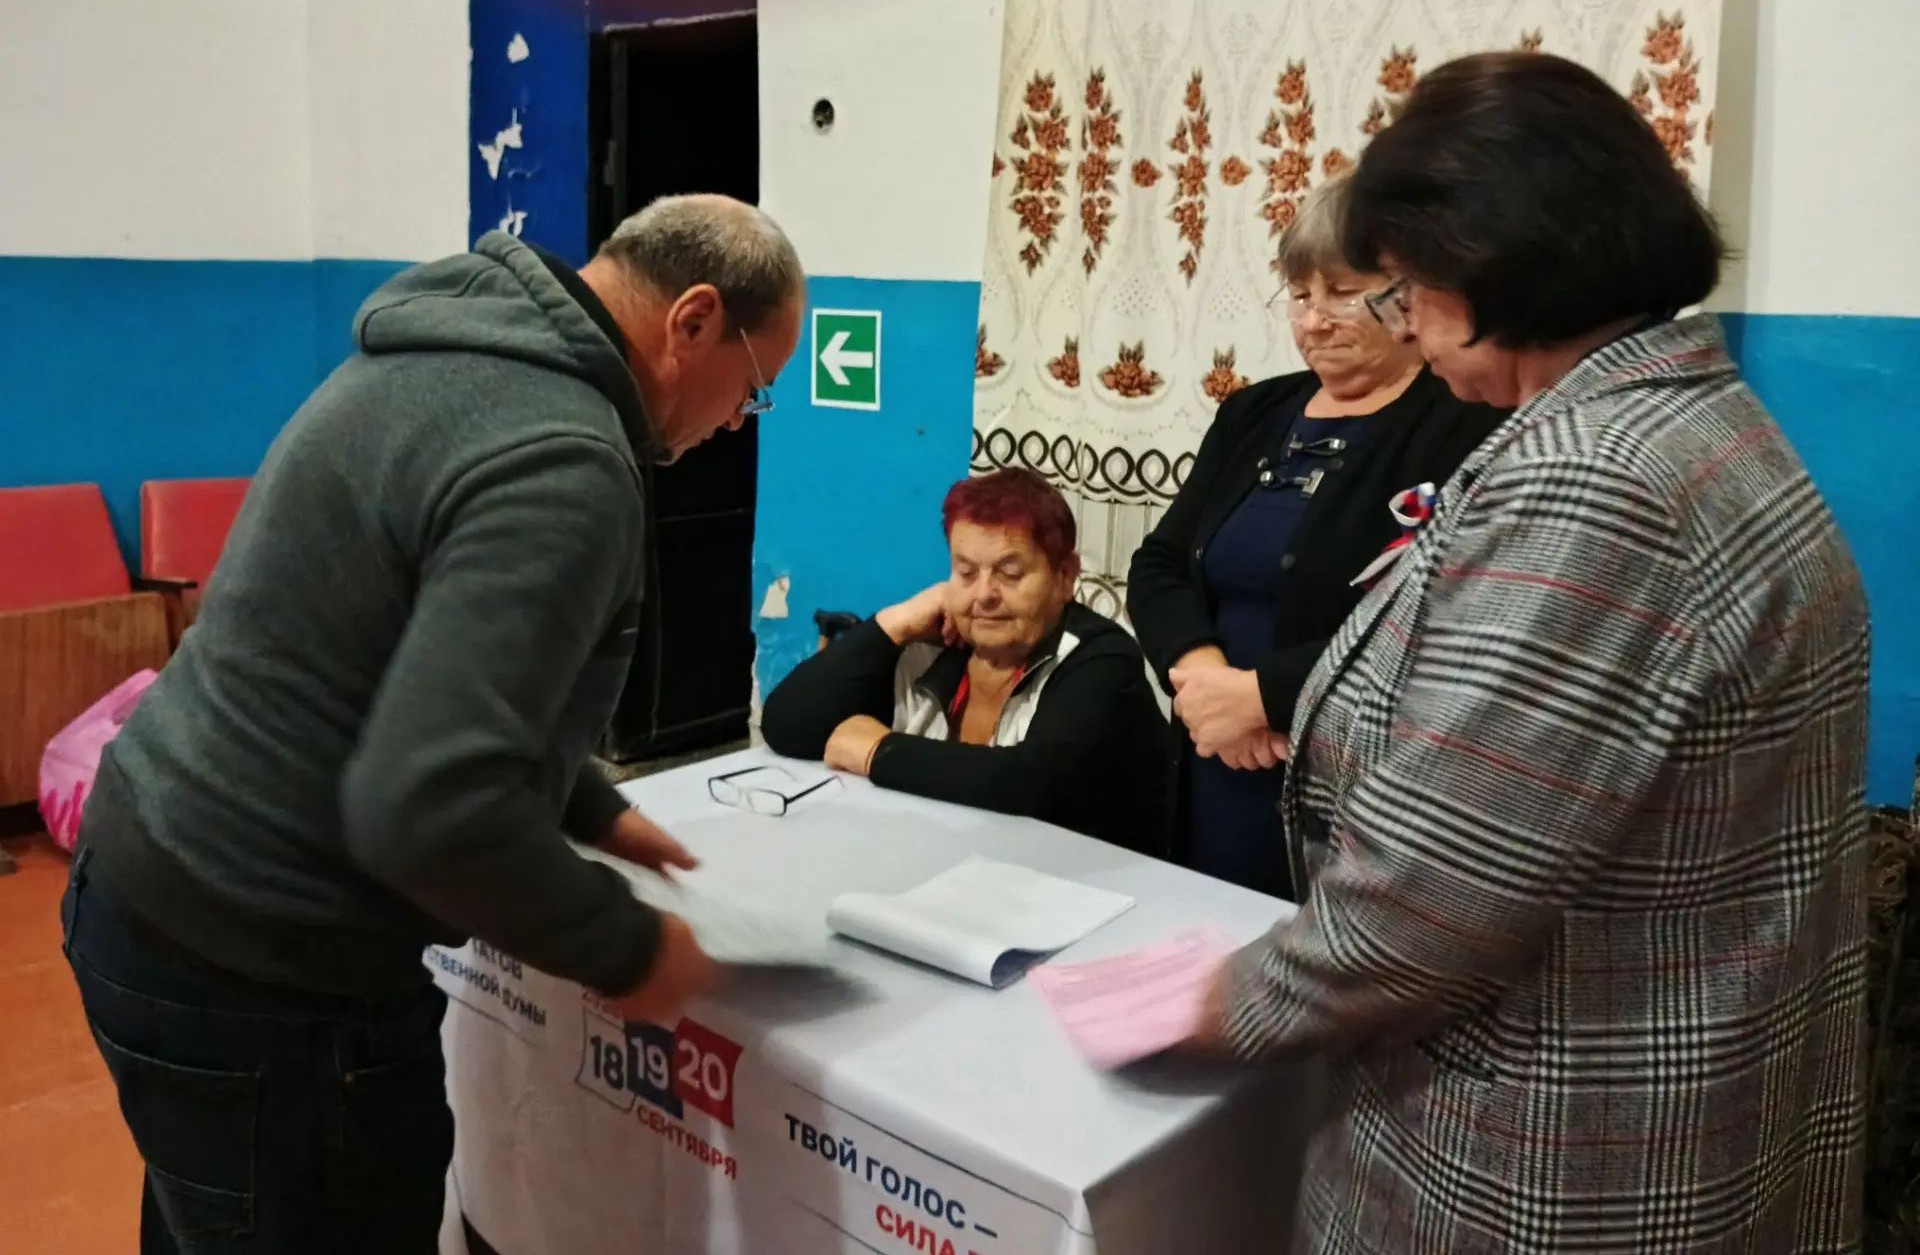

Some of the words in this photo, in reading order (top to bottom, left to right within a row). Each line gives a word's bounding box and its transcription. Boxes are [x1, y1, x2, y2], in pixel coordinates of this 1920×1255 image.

[502, 987, 547, 1027] ДУМЫ
[590, 1035, 624, 1091] 18
[631, 1036, 670, 1091] 19
[678, 1039, 728, 1101] 20
[637, 1104, 737, 1180] СЕНТЯБРЯ
[784, 1113, 858, 1174] ТВОЙ
[865, 1156, 966, 1230] ГОЛОС
